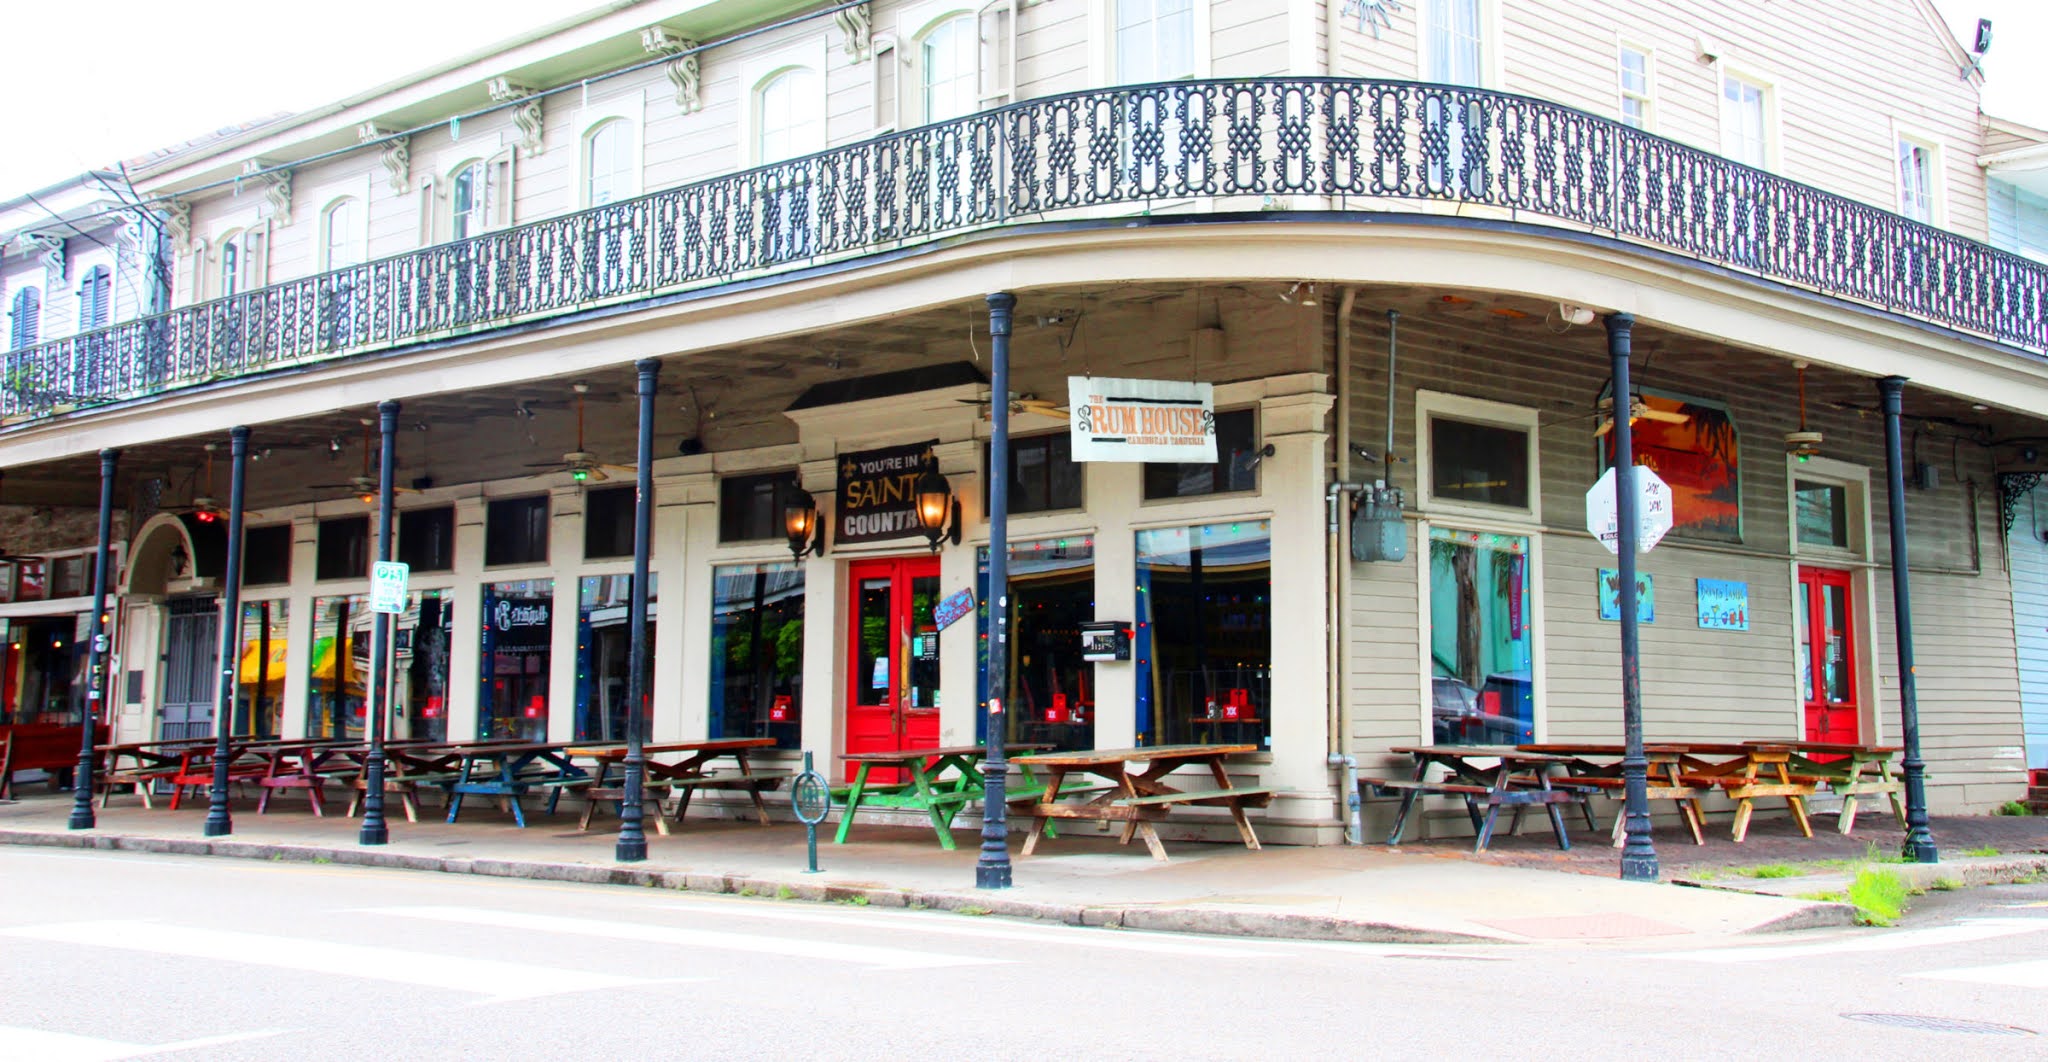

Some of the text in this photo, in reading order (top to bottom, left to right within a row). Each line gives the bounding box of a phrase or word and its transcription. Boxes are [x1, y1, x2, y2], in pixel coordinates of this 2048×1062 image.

[1089, 395, 1104, 404] THE
[1089, 405, 1206, 436] RUM HOUSE
[860, 454, 918, 474] YOU'RE IN
[846, 472, 926, 509] SAINT
[844, 509, 919, 536] COUNTR
